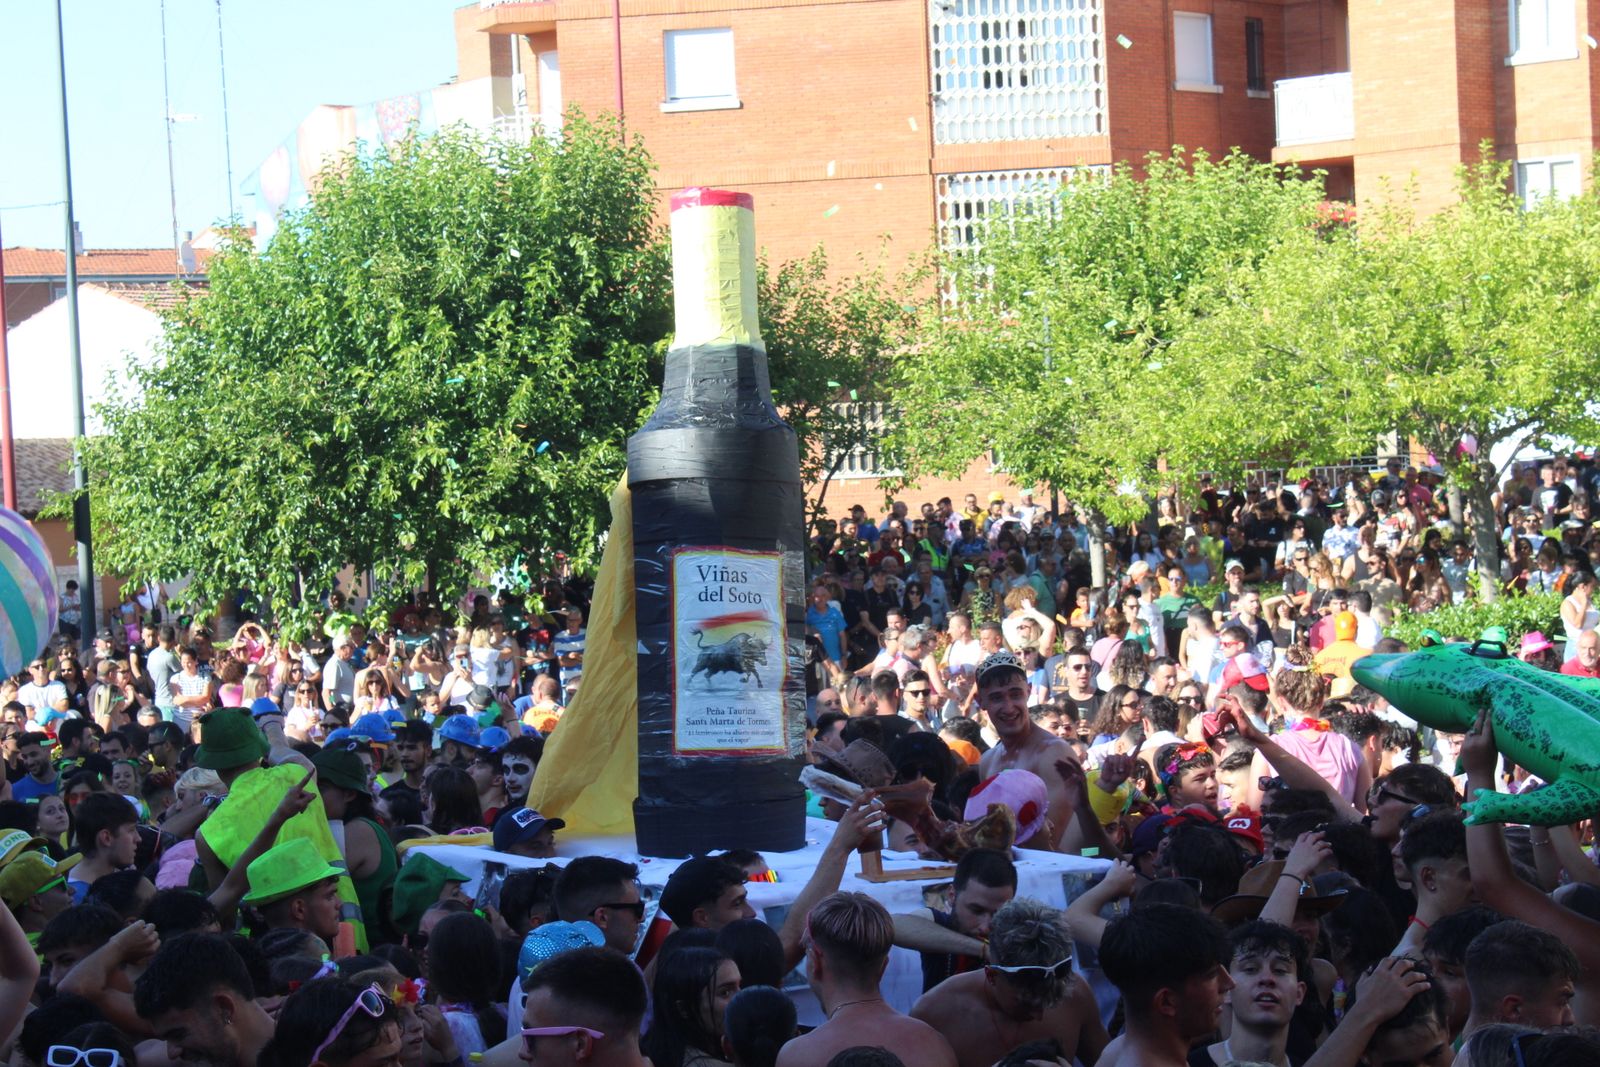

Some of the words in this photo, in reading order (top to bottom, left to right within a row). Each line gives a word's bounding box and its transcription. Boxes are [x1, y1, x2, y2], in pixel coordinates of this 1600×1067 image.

[696, 565, 747, 583] Viñas
[698, 585, 724, 602] del
[728, 586, 762, 604] Soto
[706, 707, 725, 715] Peña
[727, 707, 756, 715] Taurina
[710, 718, 734, 726] Marta
[737, 718, 745, 726] de
